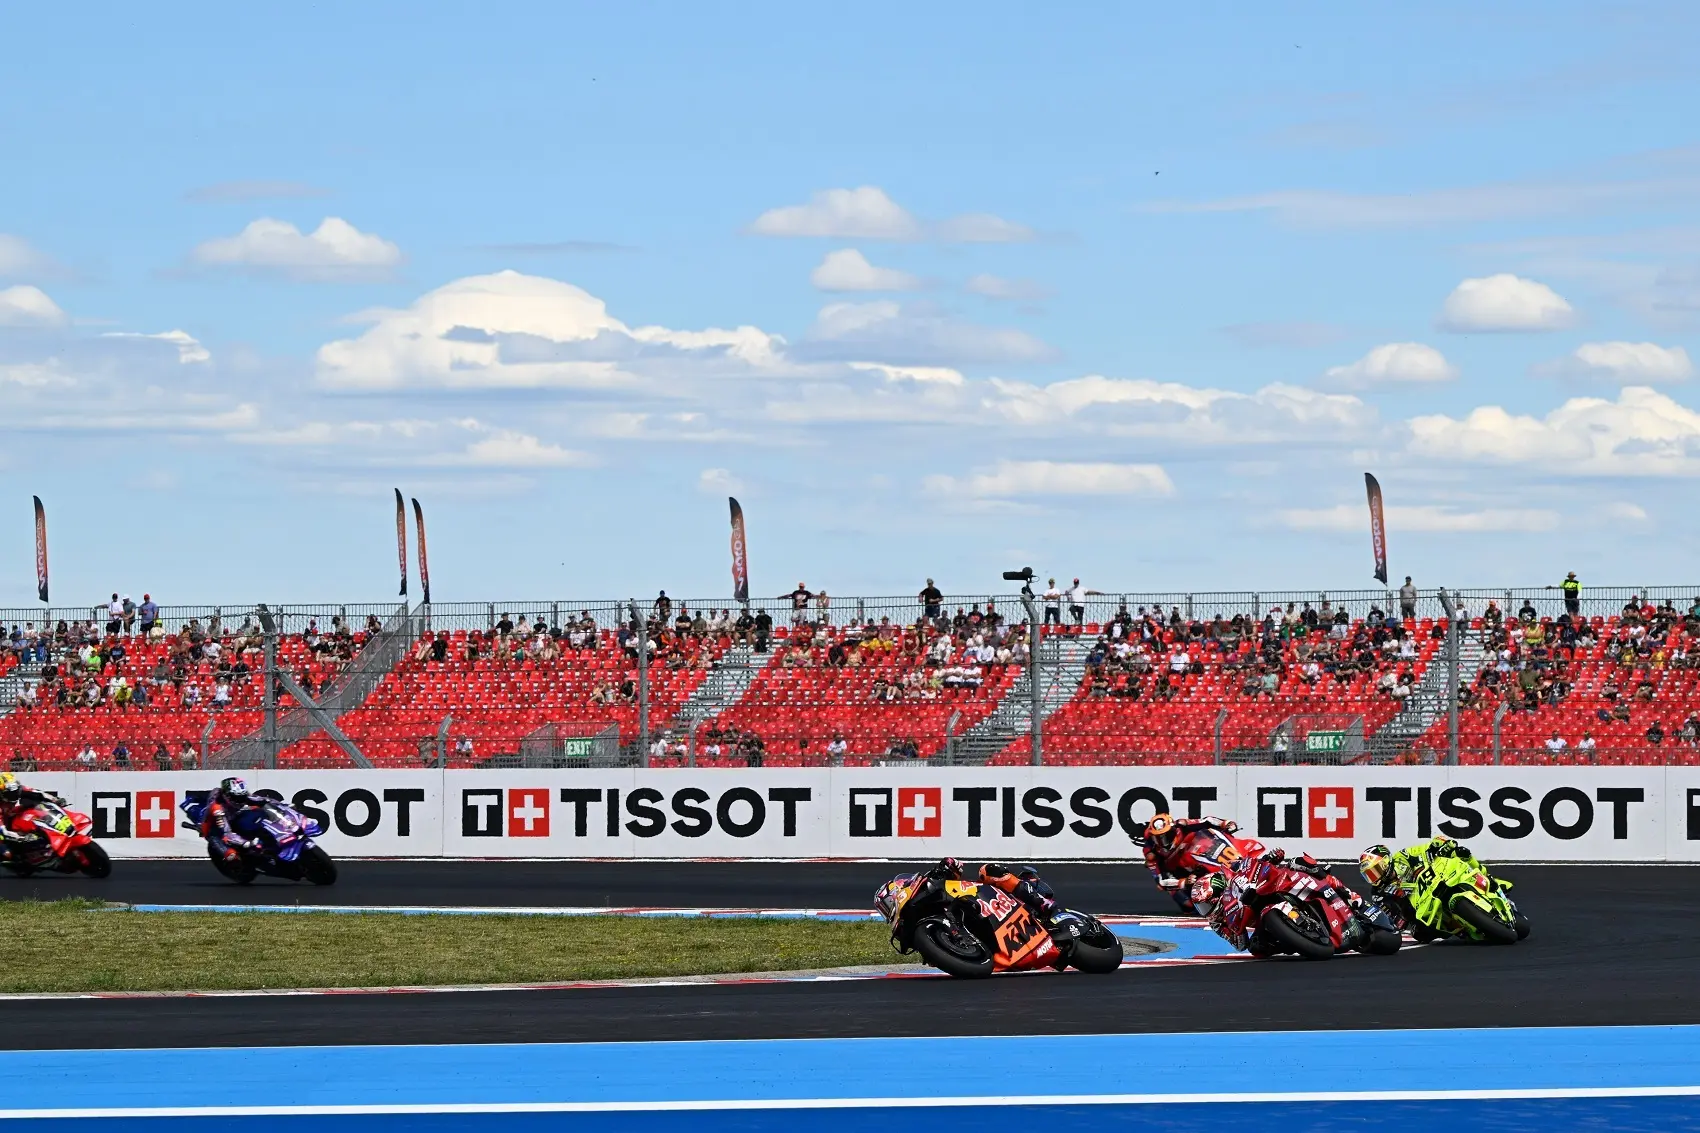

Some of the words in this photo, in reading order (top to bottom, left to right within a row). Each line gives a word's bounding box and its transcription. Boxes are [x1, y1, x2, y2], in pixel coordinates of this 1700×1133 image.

[566, 741, 592, 755] EXIT
[1308, 735, 1335, 749] EXIT
[185, 788, 425, 837] SOT
[560, 787, 812, 838] TISSOT
[952, 786, 1218, 838] TISSOT
[1366, 786, 1645, 840] TISSOT
[1217, 846, 1242, 869] 10
[1002, 913, 1043, 960] KTM
